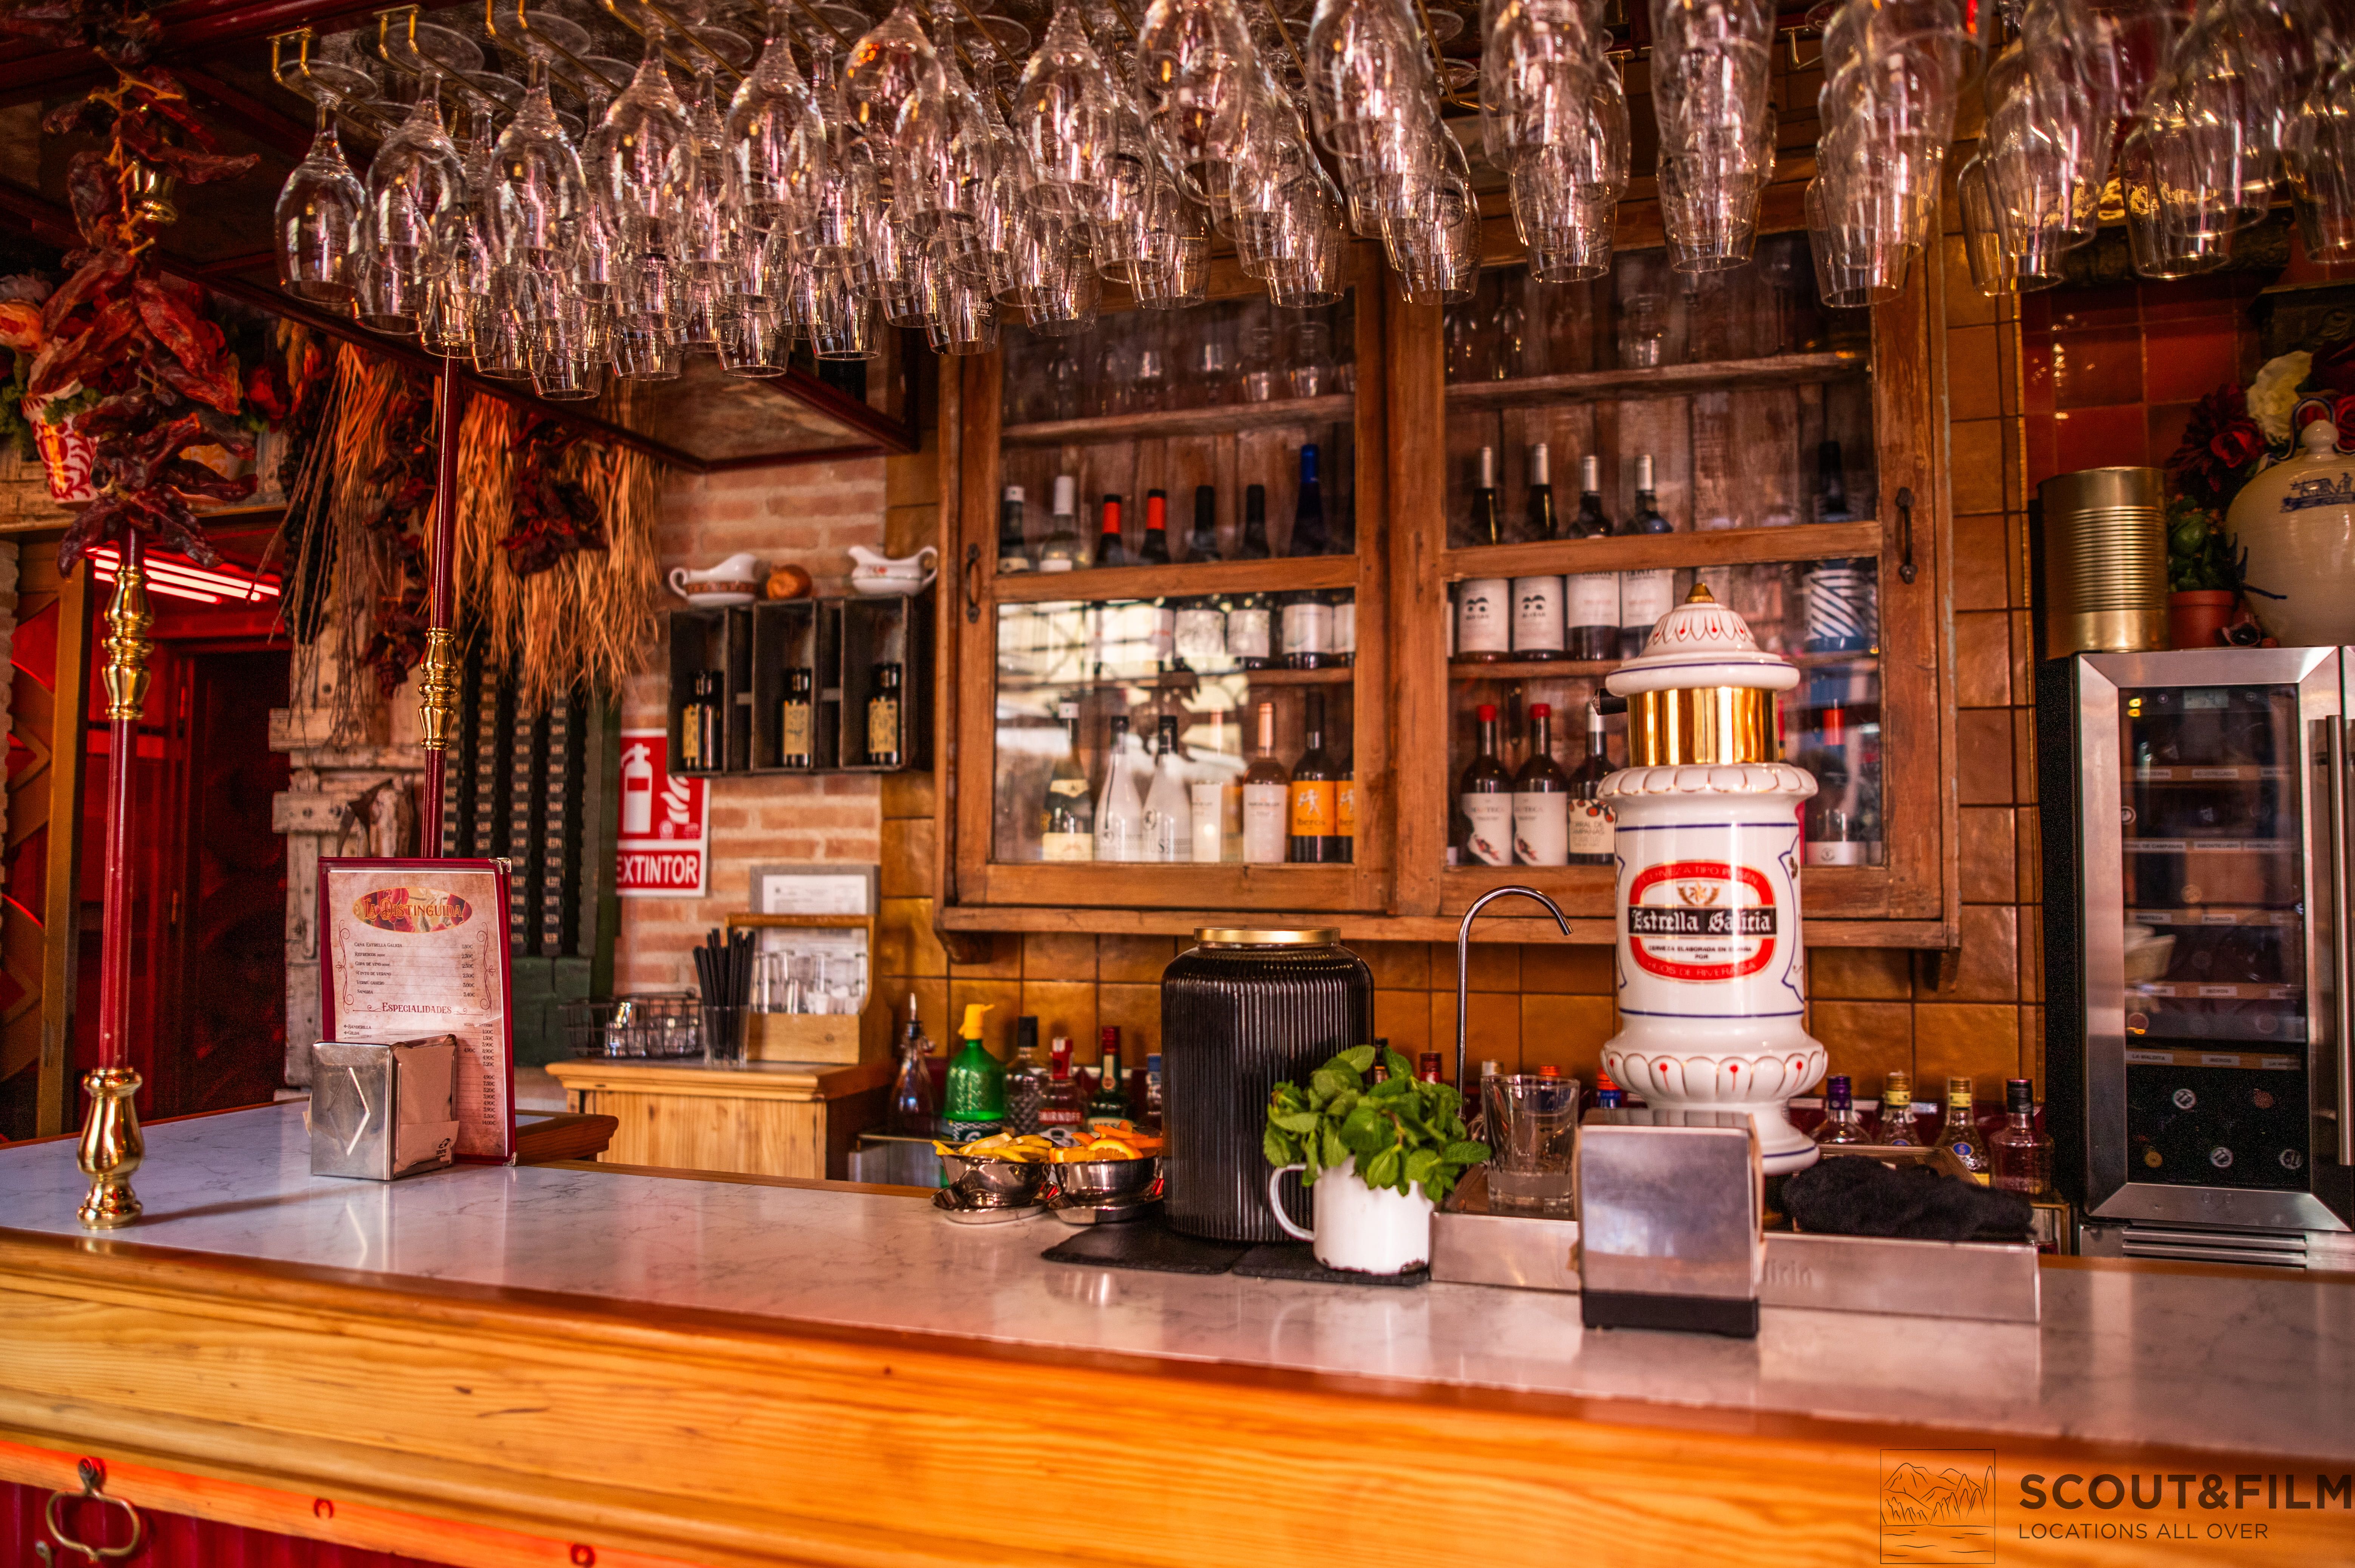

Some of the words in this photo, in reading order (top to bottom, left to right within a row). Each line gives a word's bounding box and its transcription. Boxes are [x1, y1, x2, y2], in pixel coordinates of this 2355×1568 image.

[380, 898, 462, 920] DISTINGUIDA
[1632, 910, 1699, 932] Estrella
[1708, 910, 1771, 932] Galicia
[382, 1003, 452, 1013] ESPECIALIDADES
